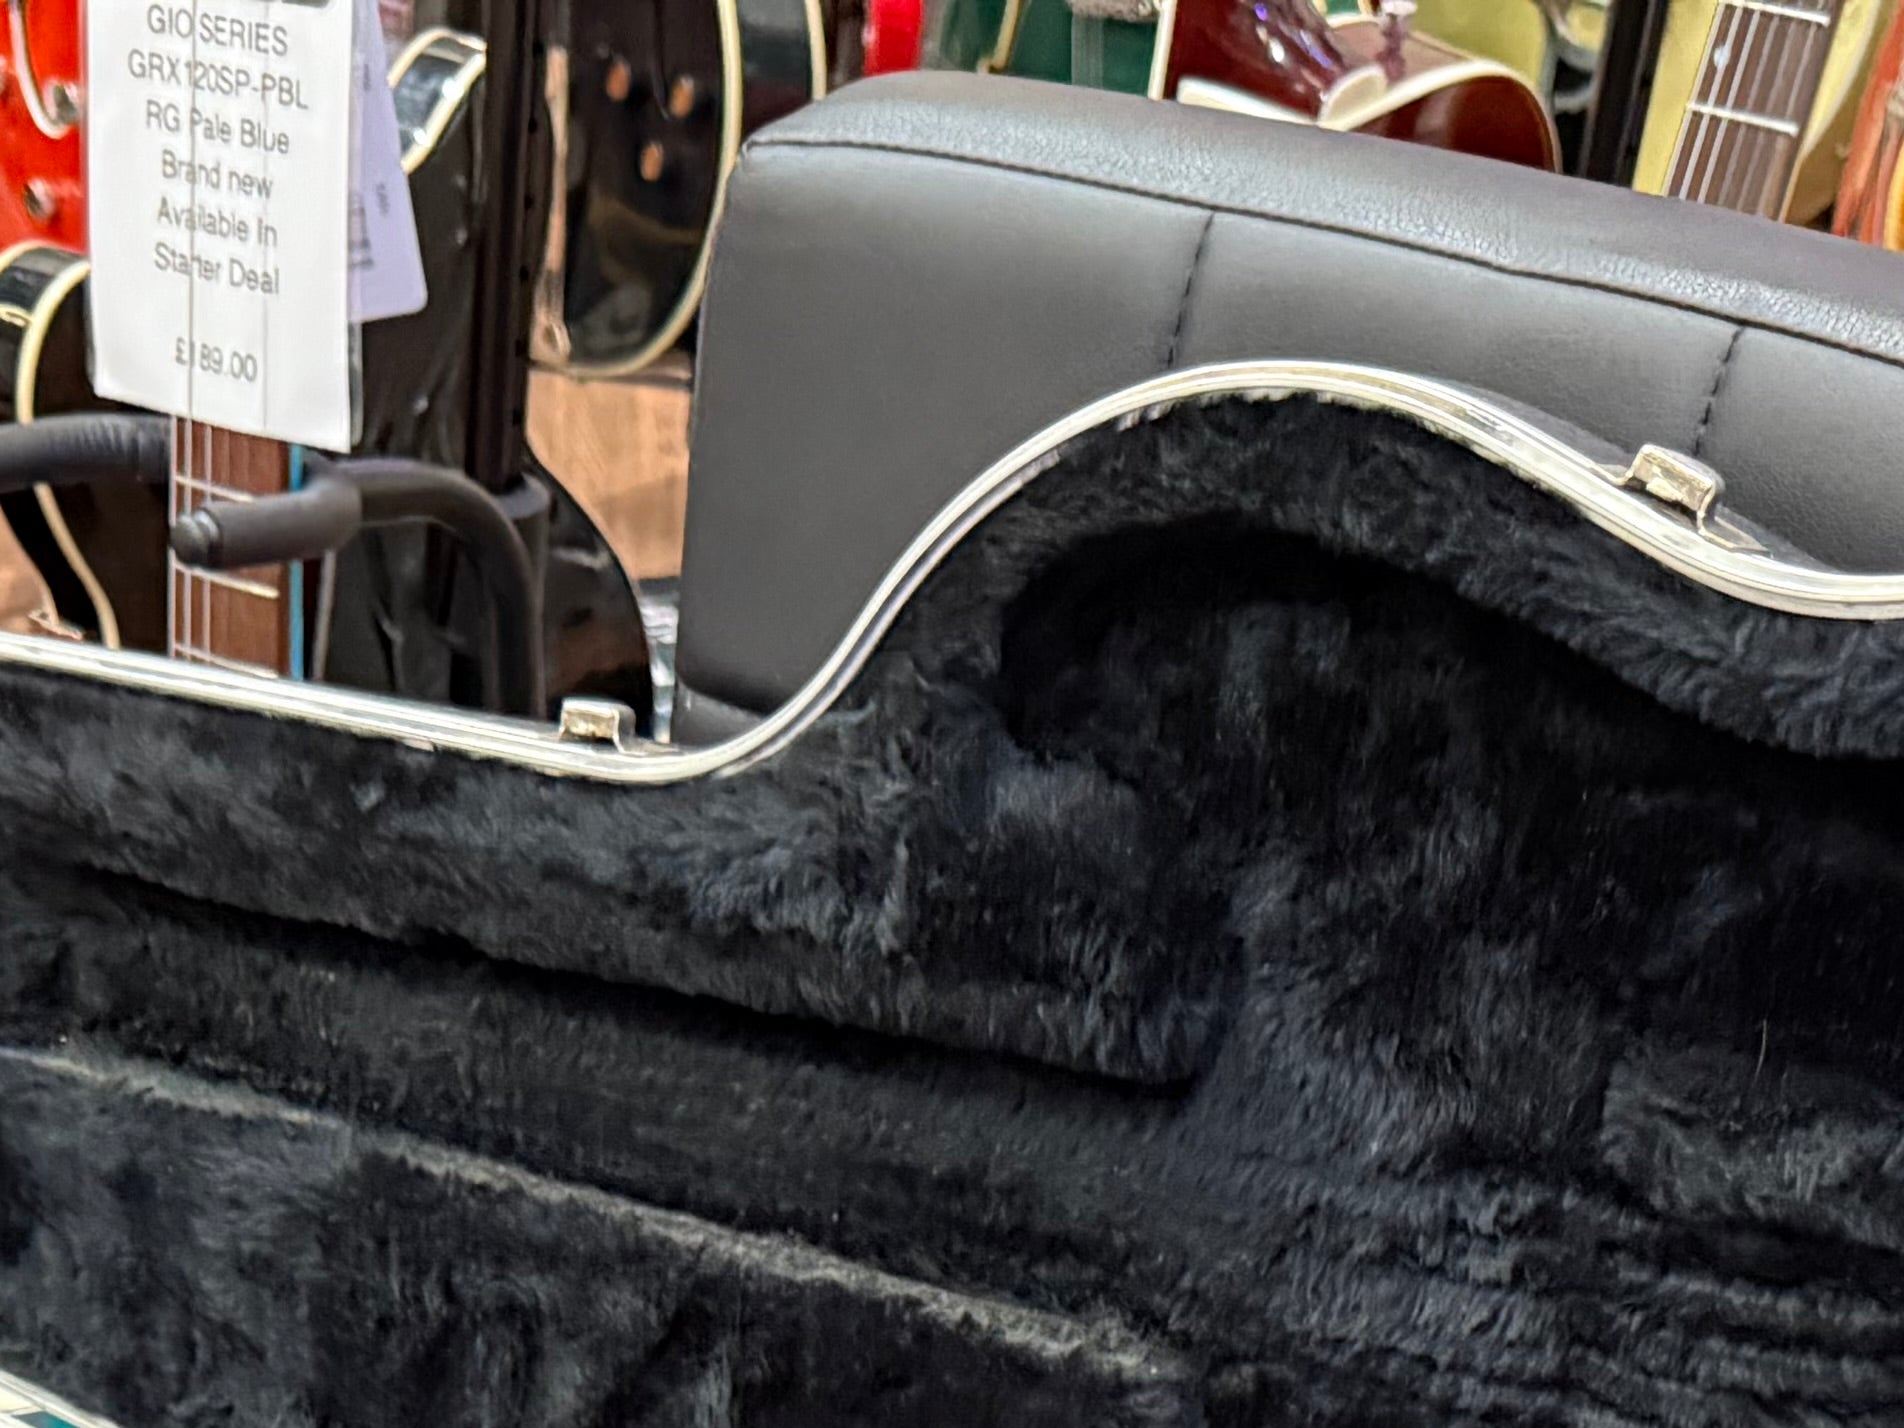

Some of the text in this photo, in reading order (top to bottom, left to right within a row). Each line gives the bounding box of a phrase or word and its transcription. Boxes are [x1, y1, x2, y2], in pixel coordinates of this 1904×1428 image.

[147, 4, 289, 57] GIO SERIES
[128, 49, 308, 110] GRX120SP-PBL
[146, 100, 290, 155] RG Pale Blue
[162, 150, 273, 200] Brand new
[157, 196, 278, 247] Available In
[154, 242, 280, 295] Starter Deal
[176, 336, 258, 383] £189.00
